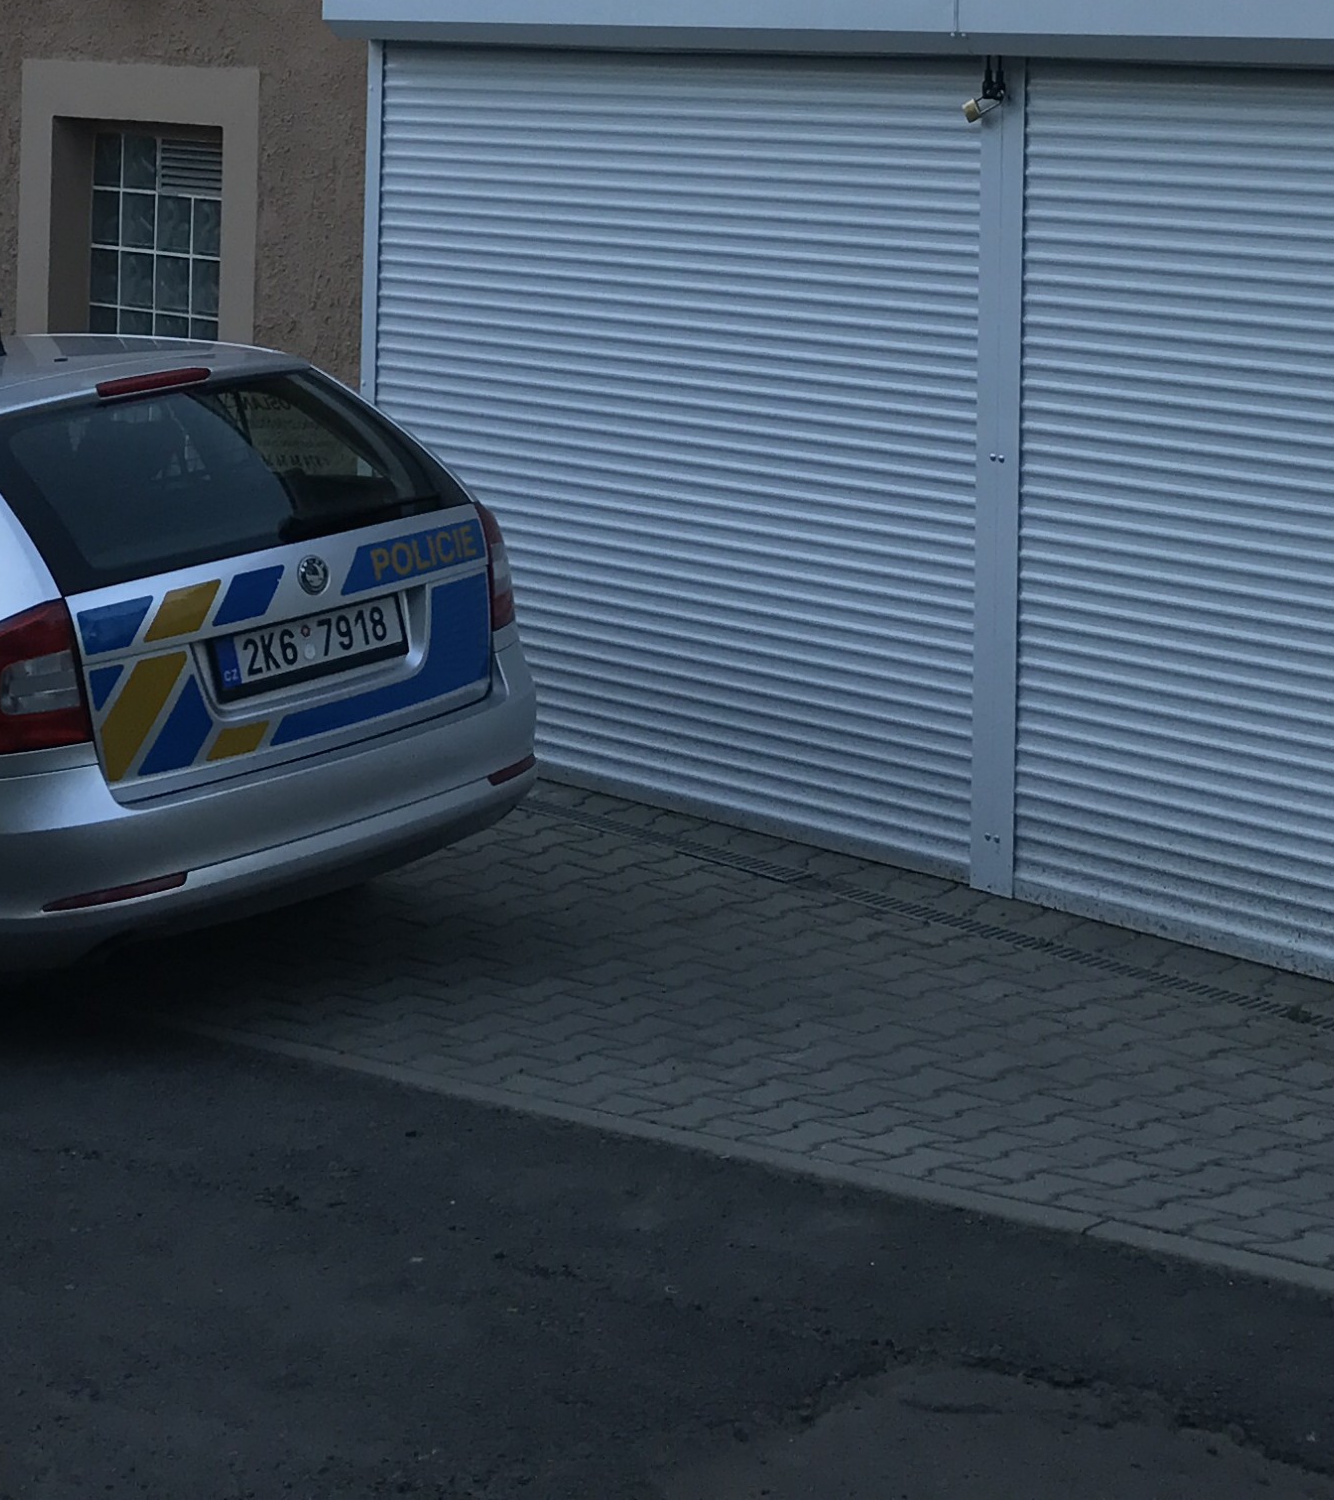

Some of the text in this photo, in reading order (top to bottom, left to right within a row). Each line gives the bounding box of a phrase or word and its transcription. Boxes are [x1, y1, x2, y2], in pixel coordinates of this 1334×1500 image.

[370, 526, 478, 581] POLICIE
[242, 606, 388, 677] 2K6 7918
[223, 668, 239, 682] CZ
